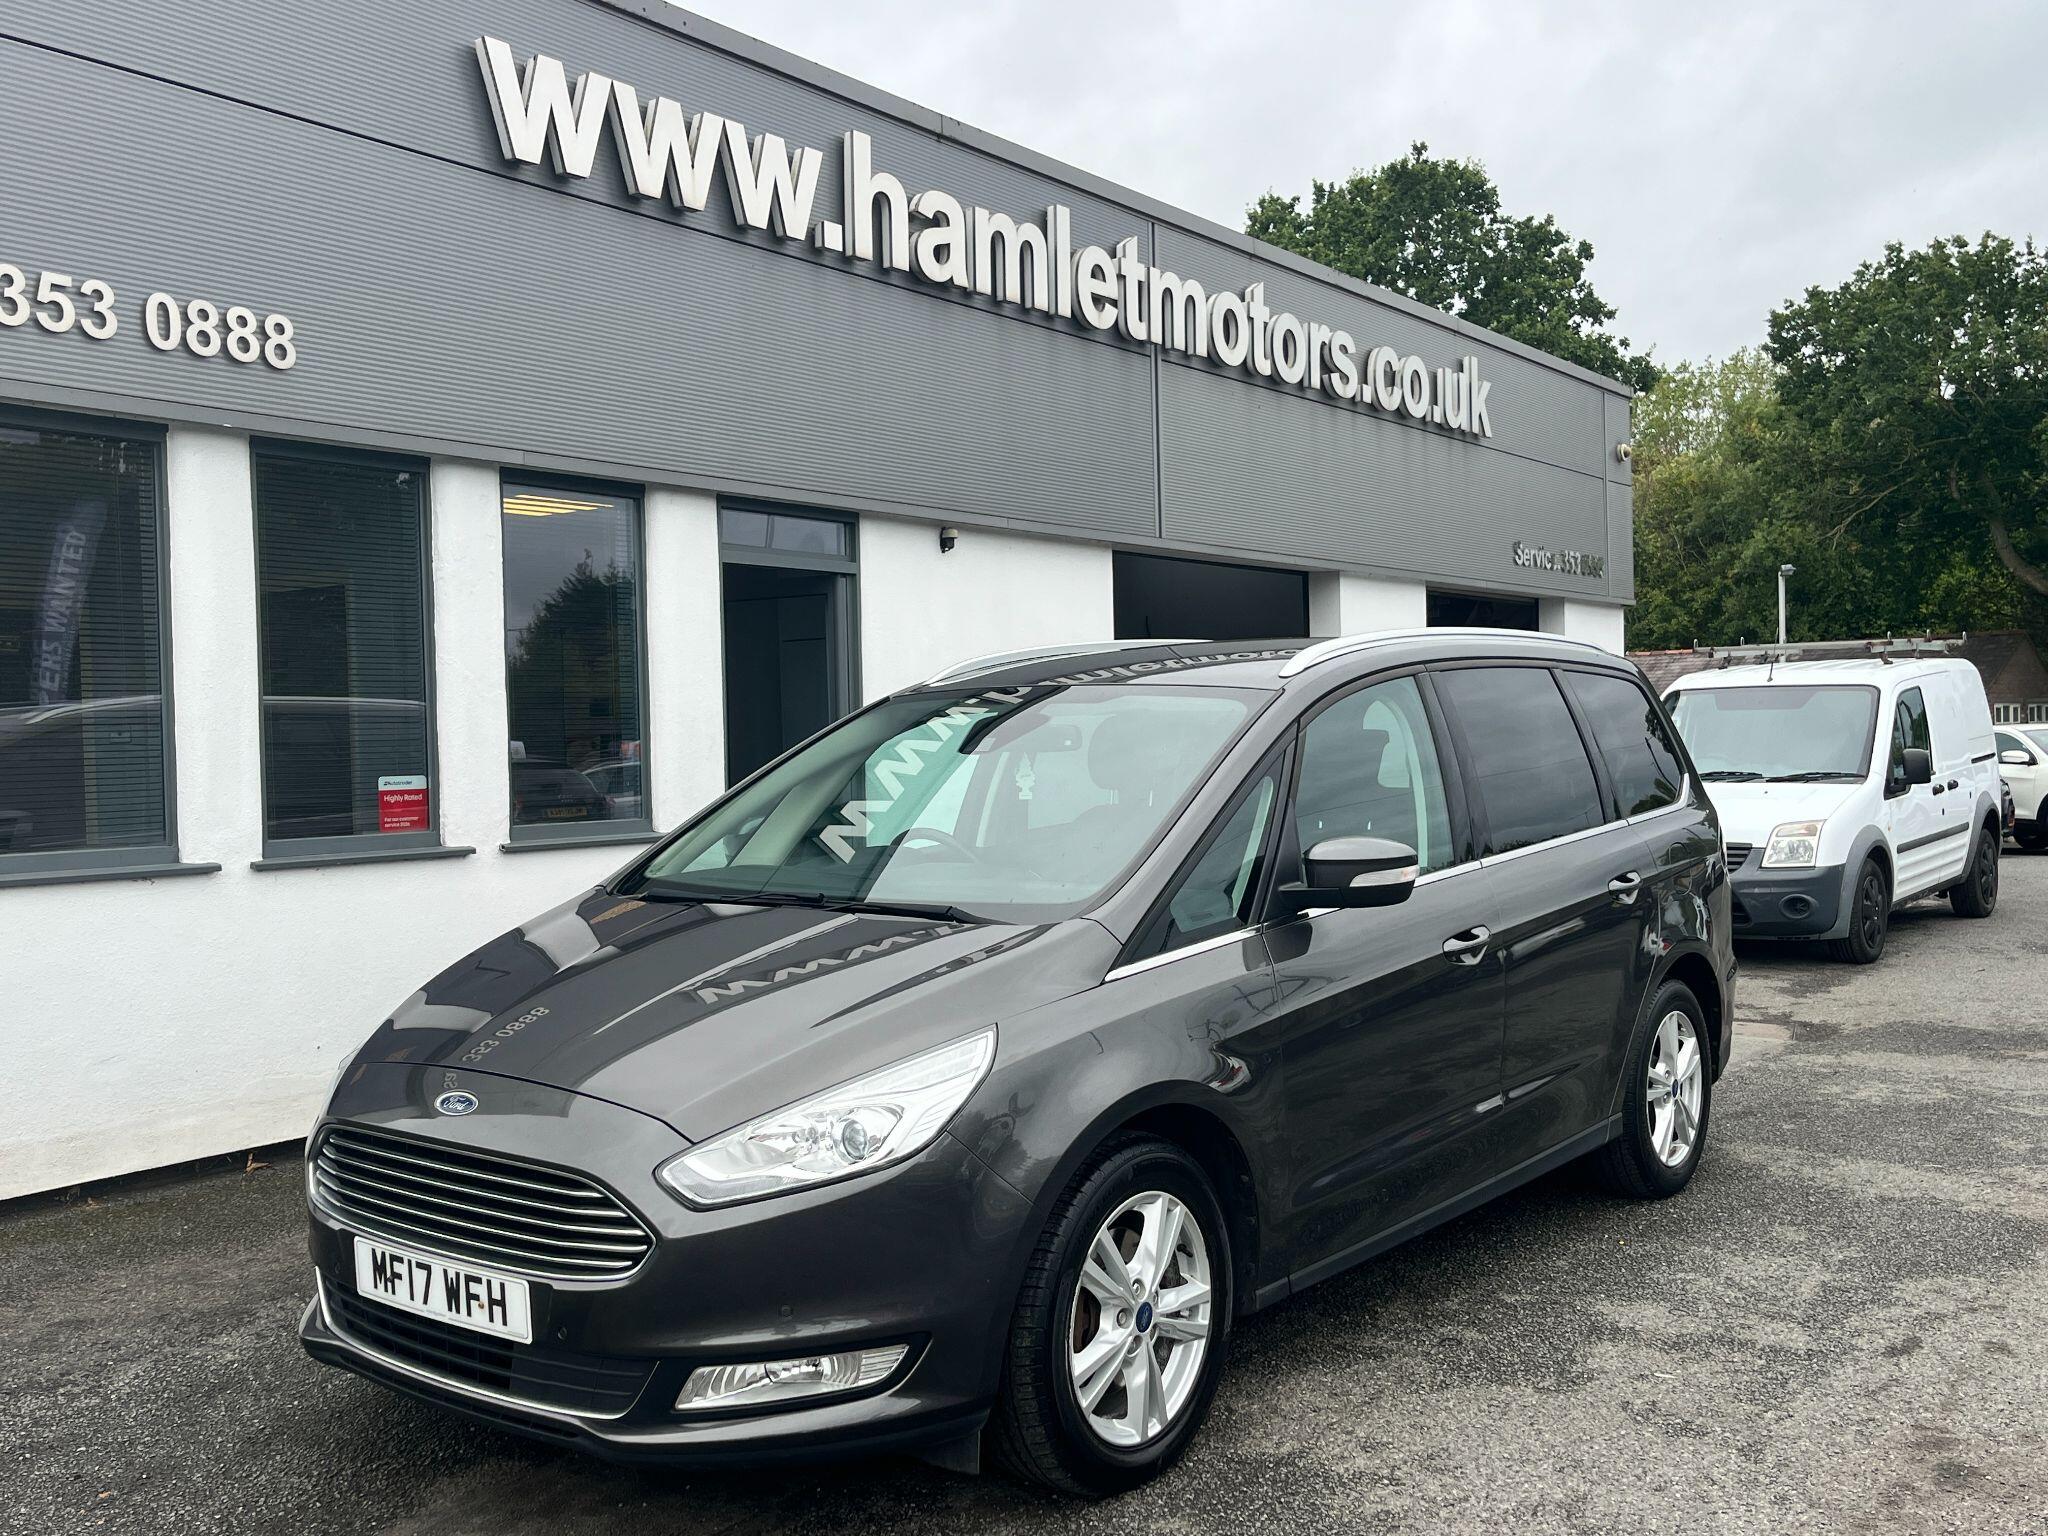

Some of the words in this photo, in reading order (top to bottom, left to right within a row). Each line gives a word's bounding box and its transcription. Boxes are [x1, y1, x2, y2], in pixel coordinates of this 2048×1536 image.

[475, 35, 1493, 438] www.hamletmotors.co.uk
[0, 263, 118, 340] 353
[145, 292, 297, 370] 0888
[384, 794, 404, 803] Highly
[404, 793, 423, 801] Rated
[443, 1095, 470, 1111] Ford
[371, 1247, 432, 1305] MF17
[442, 1268, 508, 1327] WFH
